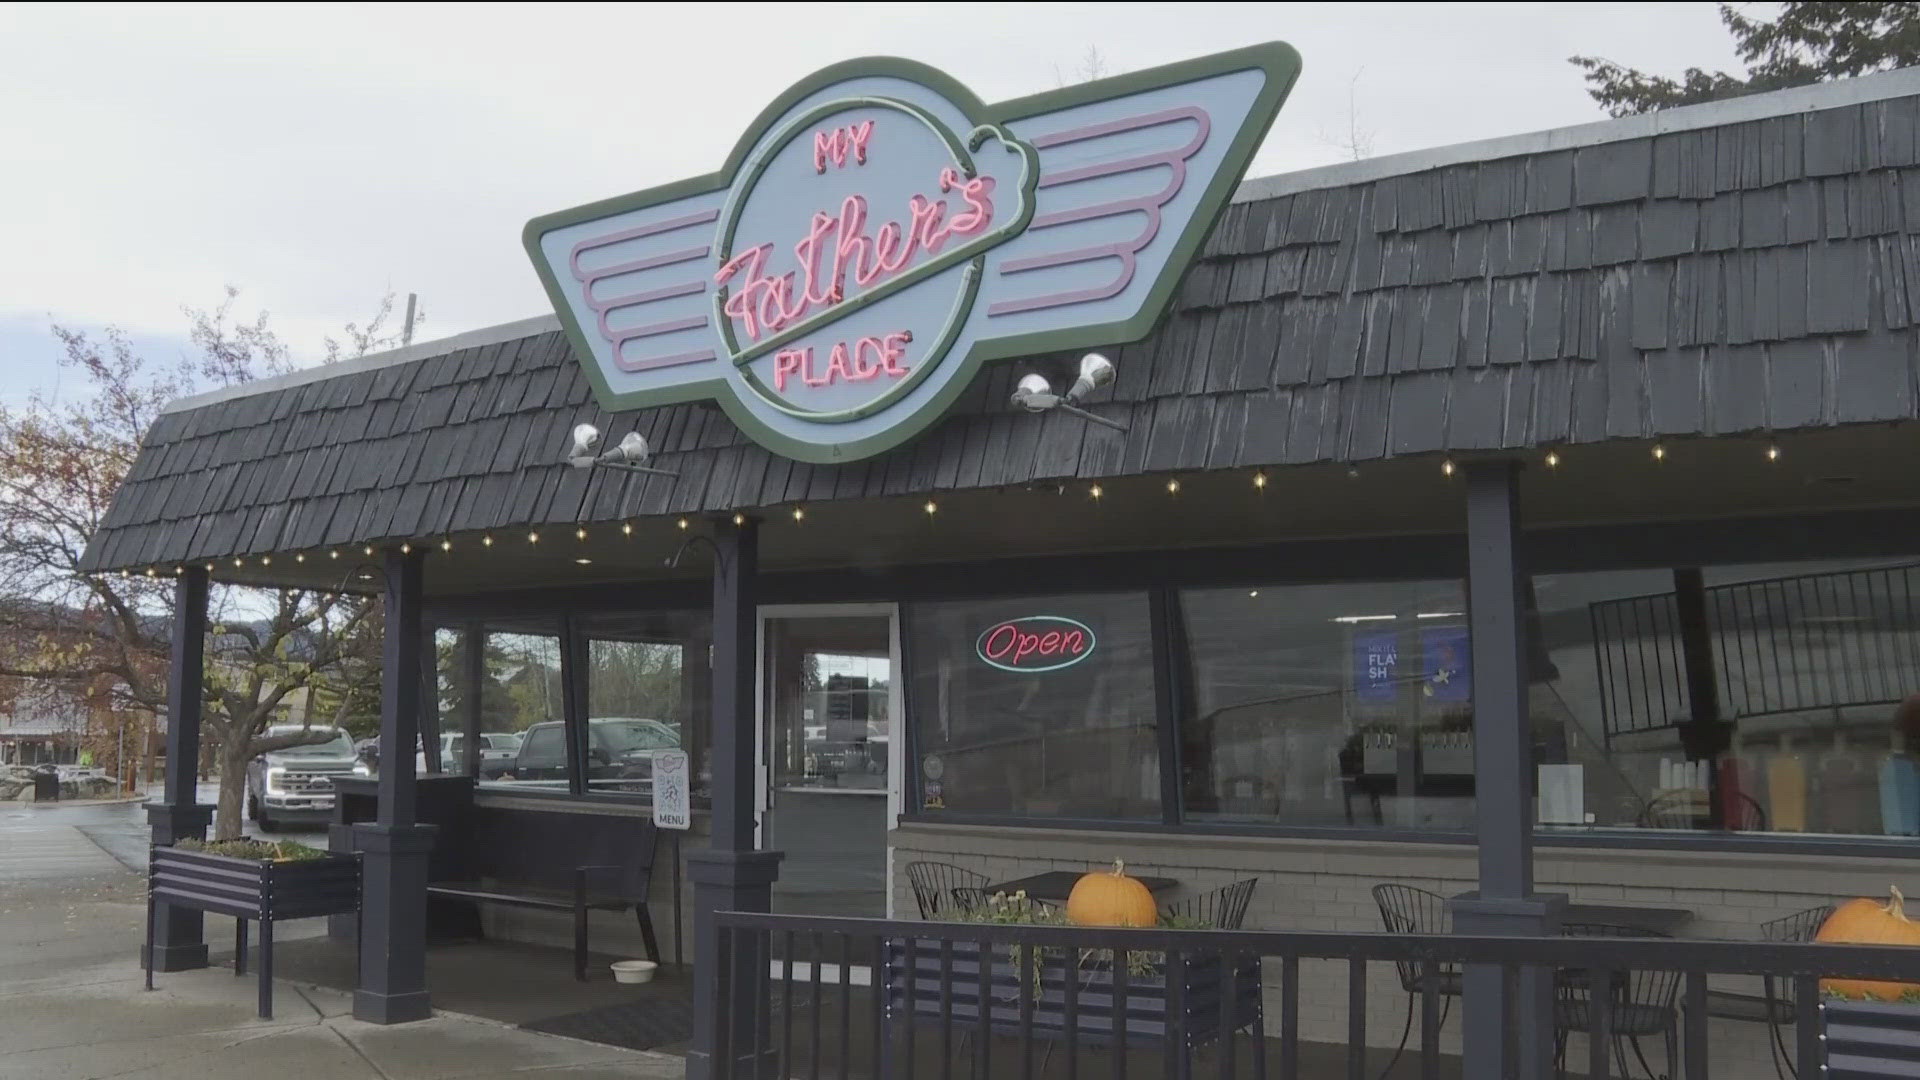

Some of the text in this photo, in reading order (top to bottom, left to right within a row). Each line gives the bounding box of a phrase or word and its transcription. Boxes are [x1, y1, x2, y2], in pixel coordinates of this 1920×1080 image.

[814, 120, 874, 175] MY
[714, 167, 997, 340] Father's
[773, 330, 914, 393] PLACE
[985, 625, 1084, 665] Open
[1368, 667, 1387, 679] SH
[659, 813, 685, 825] MENU
